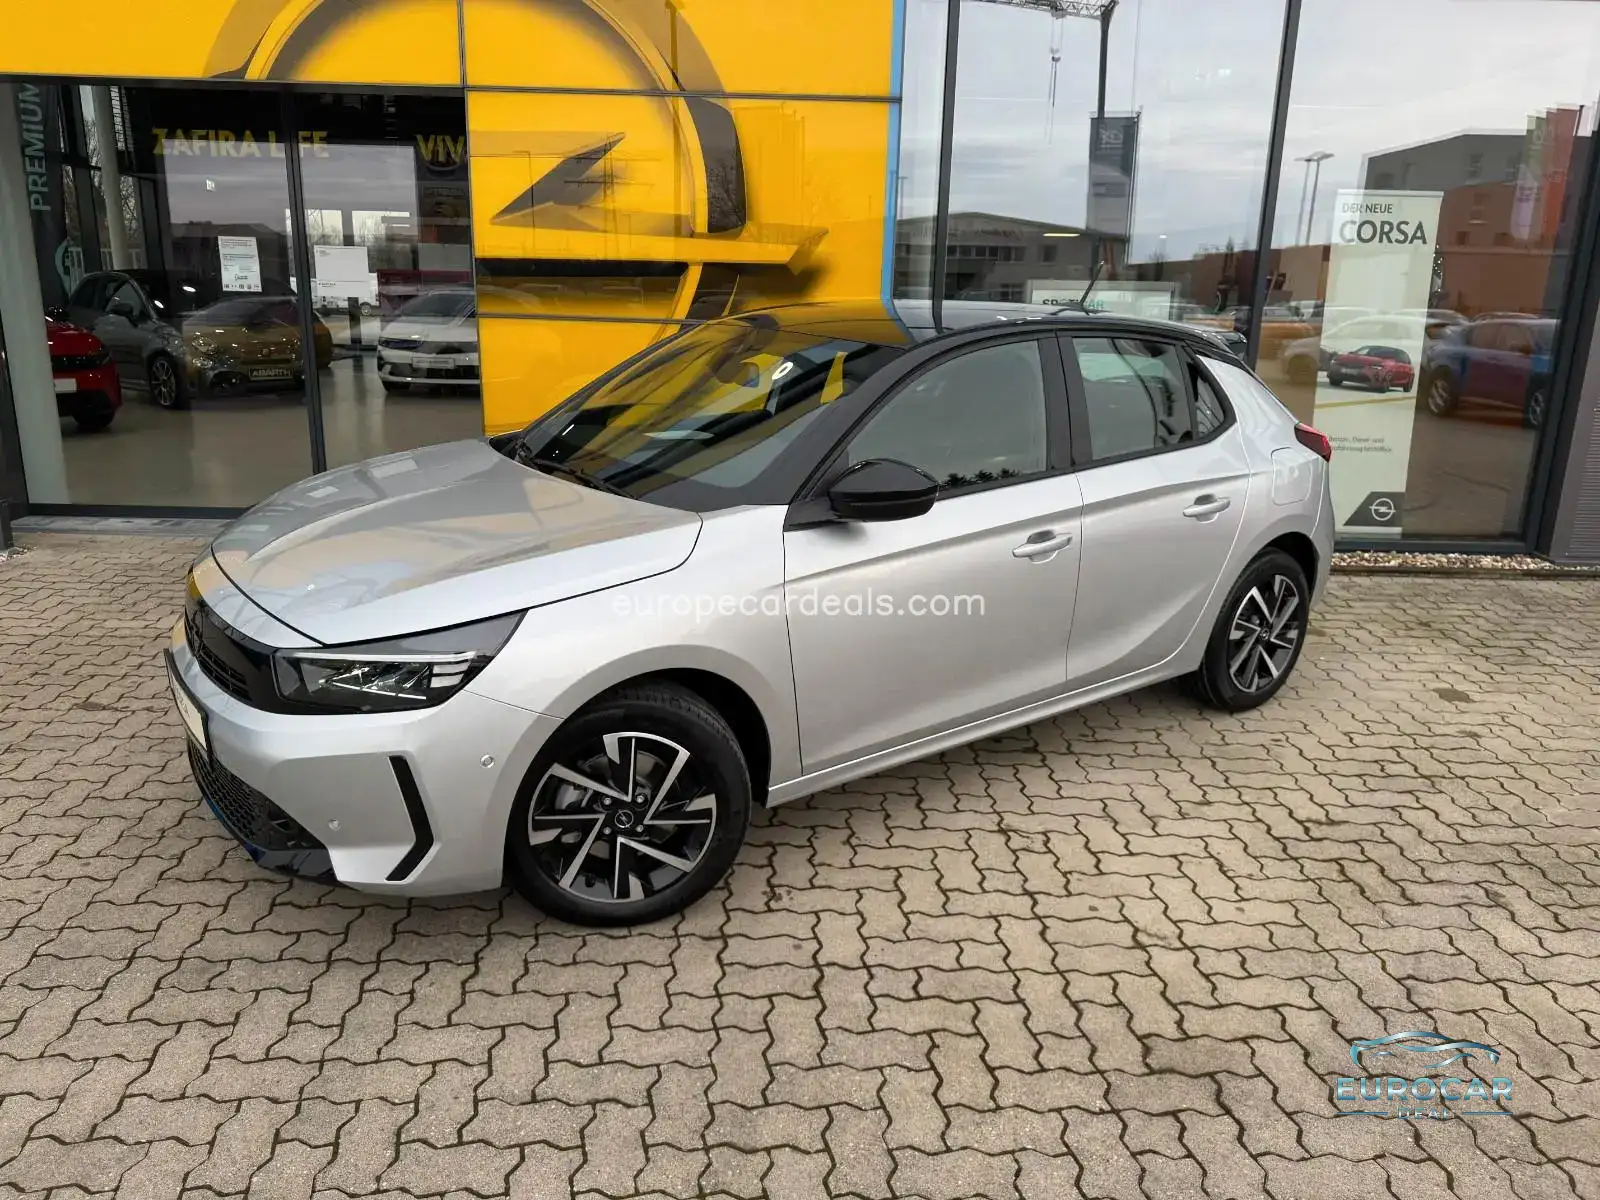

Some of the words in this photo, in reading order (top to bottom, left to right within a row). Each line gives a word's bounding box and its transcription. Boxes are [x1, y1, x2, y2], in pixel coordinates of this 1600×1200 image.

[151, 127, 262, 158] ZAFIRA
[267, 130, 330, 158] LFE
[1342, 202, 1363, 214] DER
[1364, 203, 1394, 214] NEUE
[1339, 219, 1428, 245] CORSA
